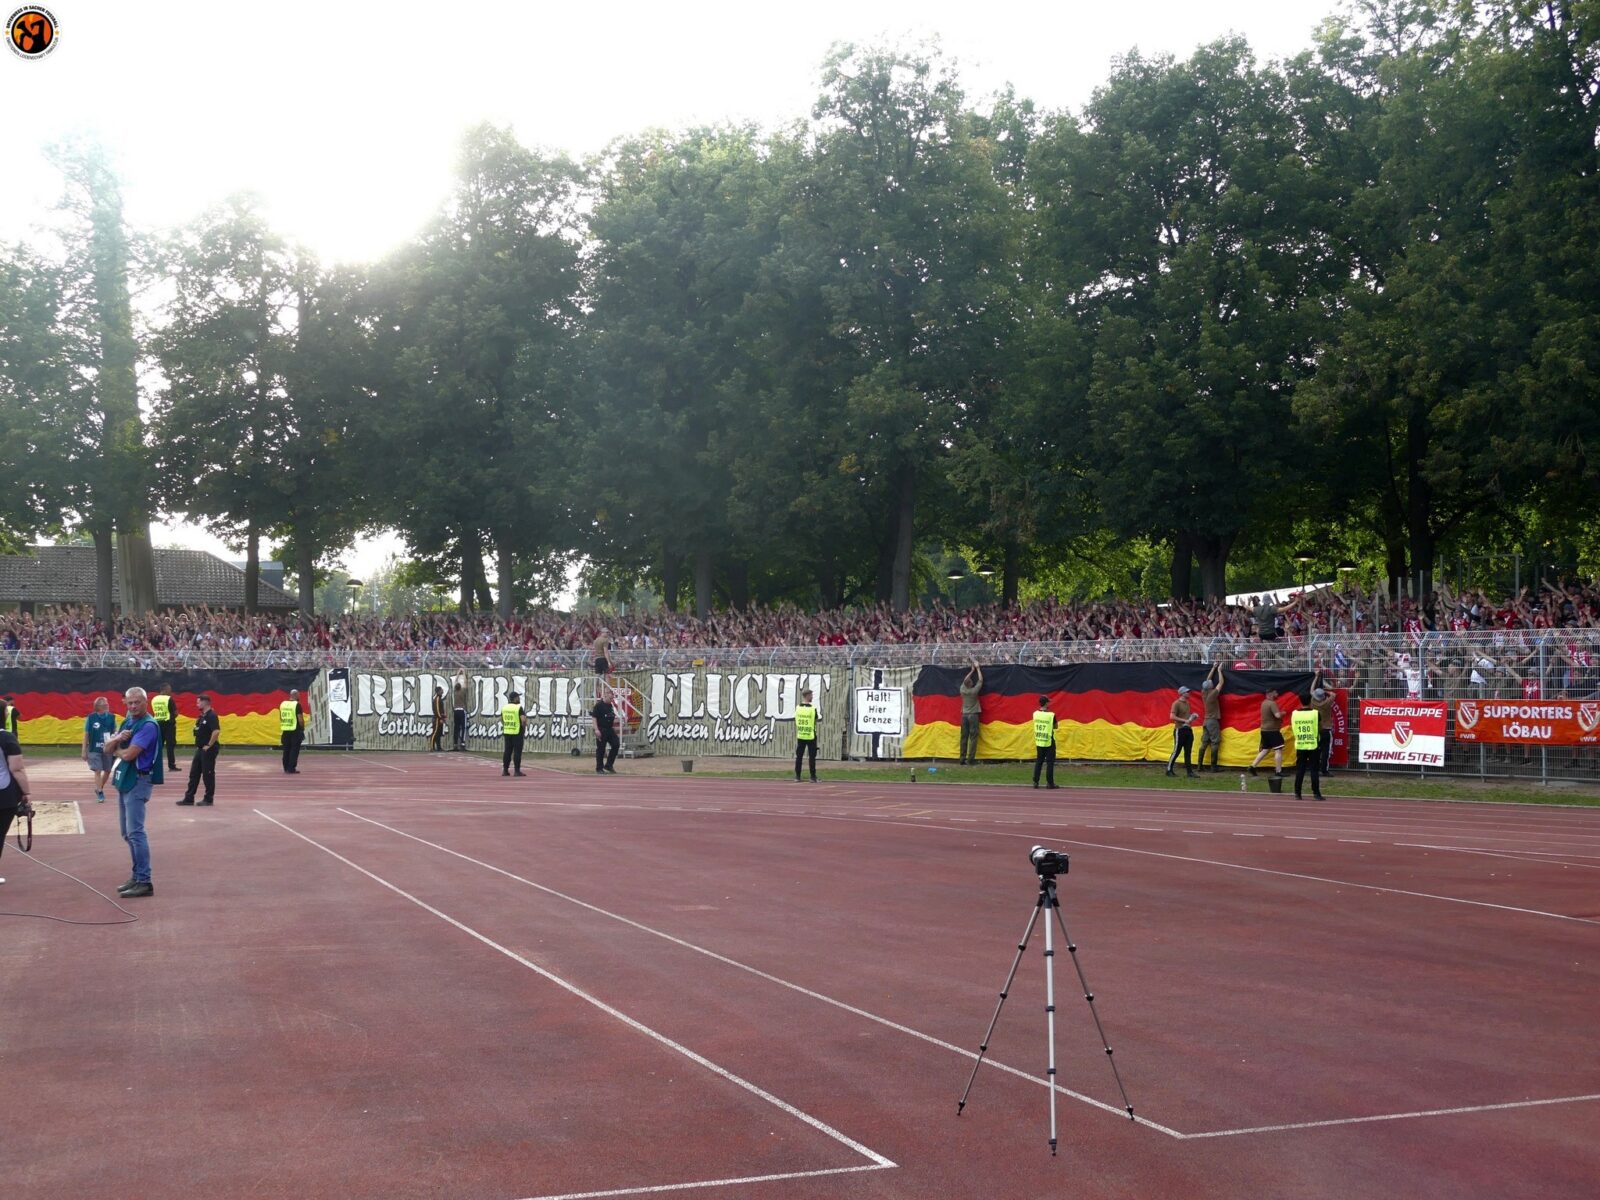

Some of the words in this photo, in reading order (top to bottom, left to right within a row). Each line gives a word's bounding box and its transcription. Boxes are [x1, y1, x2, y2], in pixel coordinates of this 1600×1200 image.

[649, 673, 831, 721] FLUCHT
[868, 705, 887, 714] Hier
[1364, 706, 1443, 718] REISEGRUPPE
[1483, 705, 1573, 720] SUPPORTERS
[863, 715, 892, 724] Grenze
[647, 714, 709, 743] Grenzen
[714, 716, 776, 745] hinweg!
[1298, 725, 1311, 733] 180
[1502, 721, 1552, 739] LÖBAU
[1363, 750, 1407, 761] SAHNIG
[1407, 752, 1443, 764] STEIF
